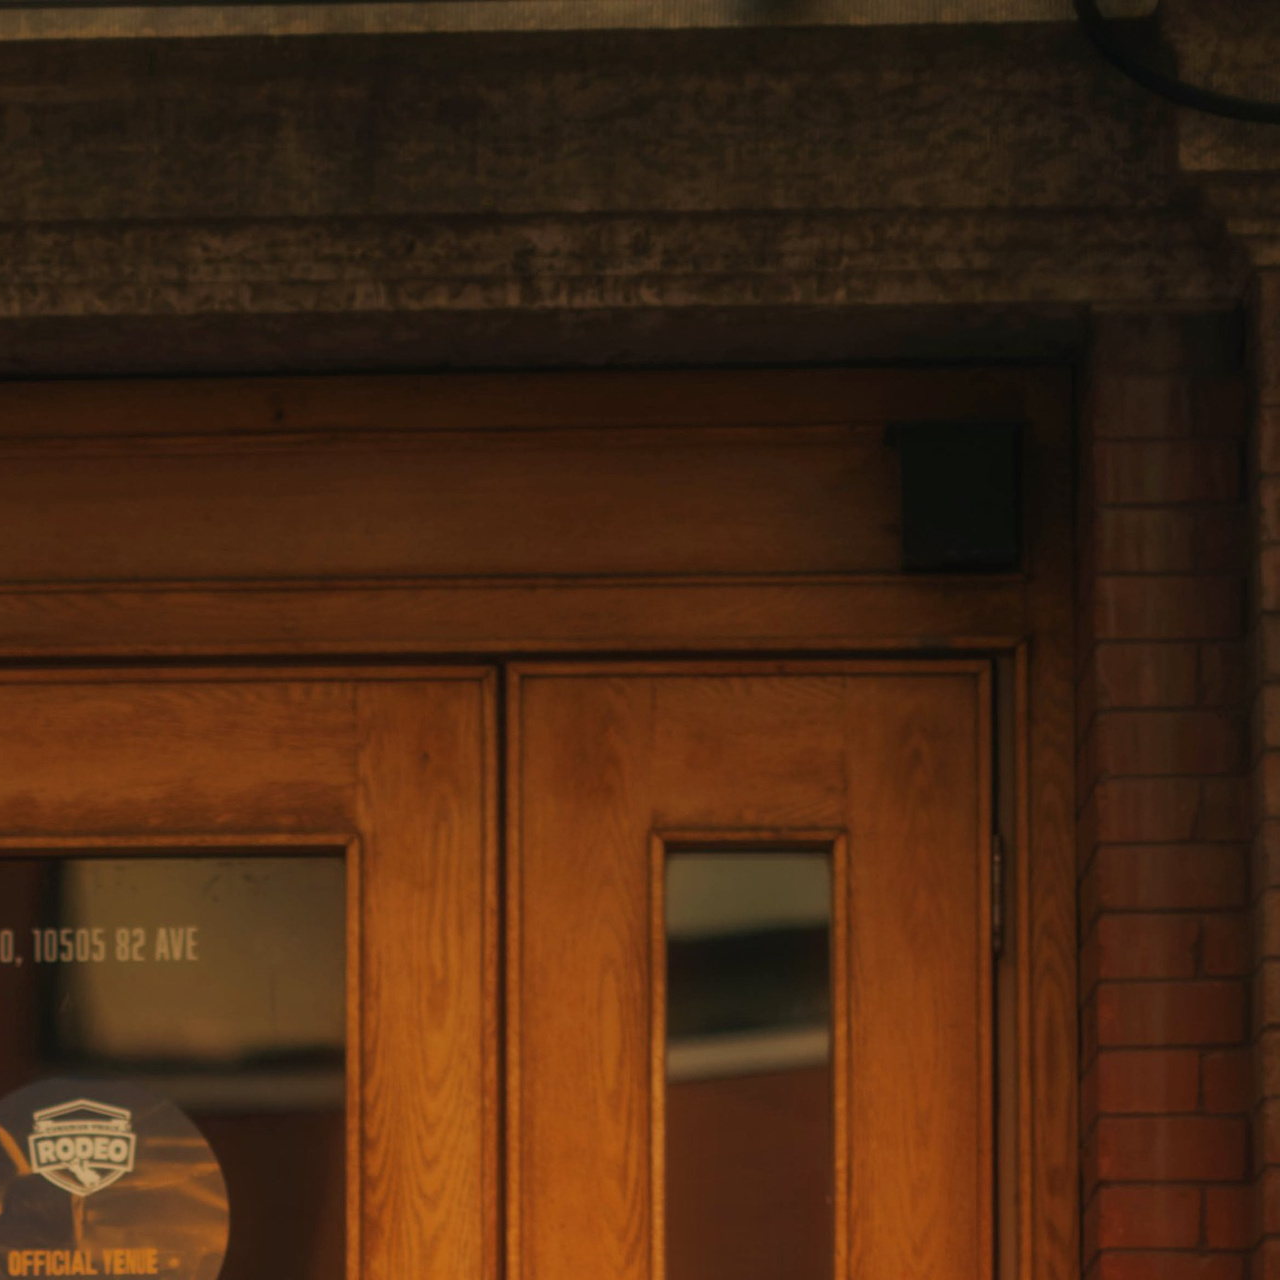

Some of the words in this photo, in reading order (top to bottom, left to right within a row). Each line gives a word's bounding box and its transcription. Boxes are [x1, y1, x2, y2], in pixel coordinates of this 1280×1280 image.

[32, 927, 106, 964] 10505
[115, 926, 147, 962] 82
[154, 926, 200, 961] AVE
[37, 1136, 129, 1164] RODEO
[8, 1249, 98, 1276] OFFICIAL
[102, 1247, 159, 1275] VENUE
